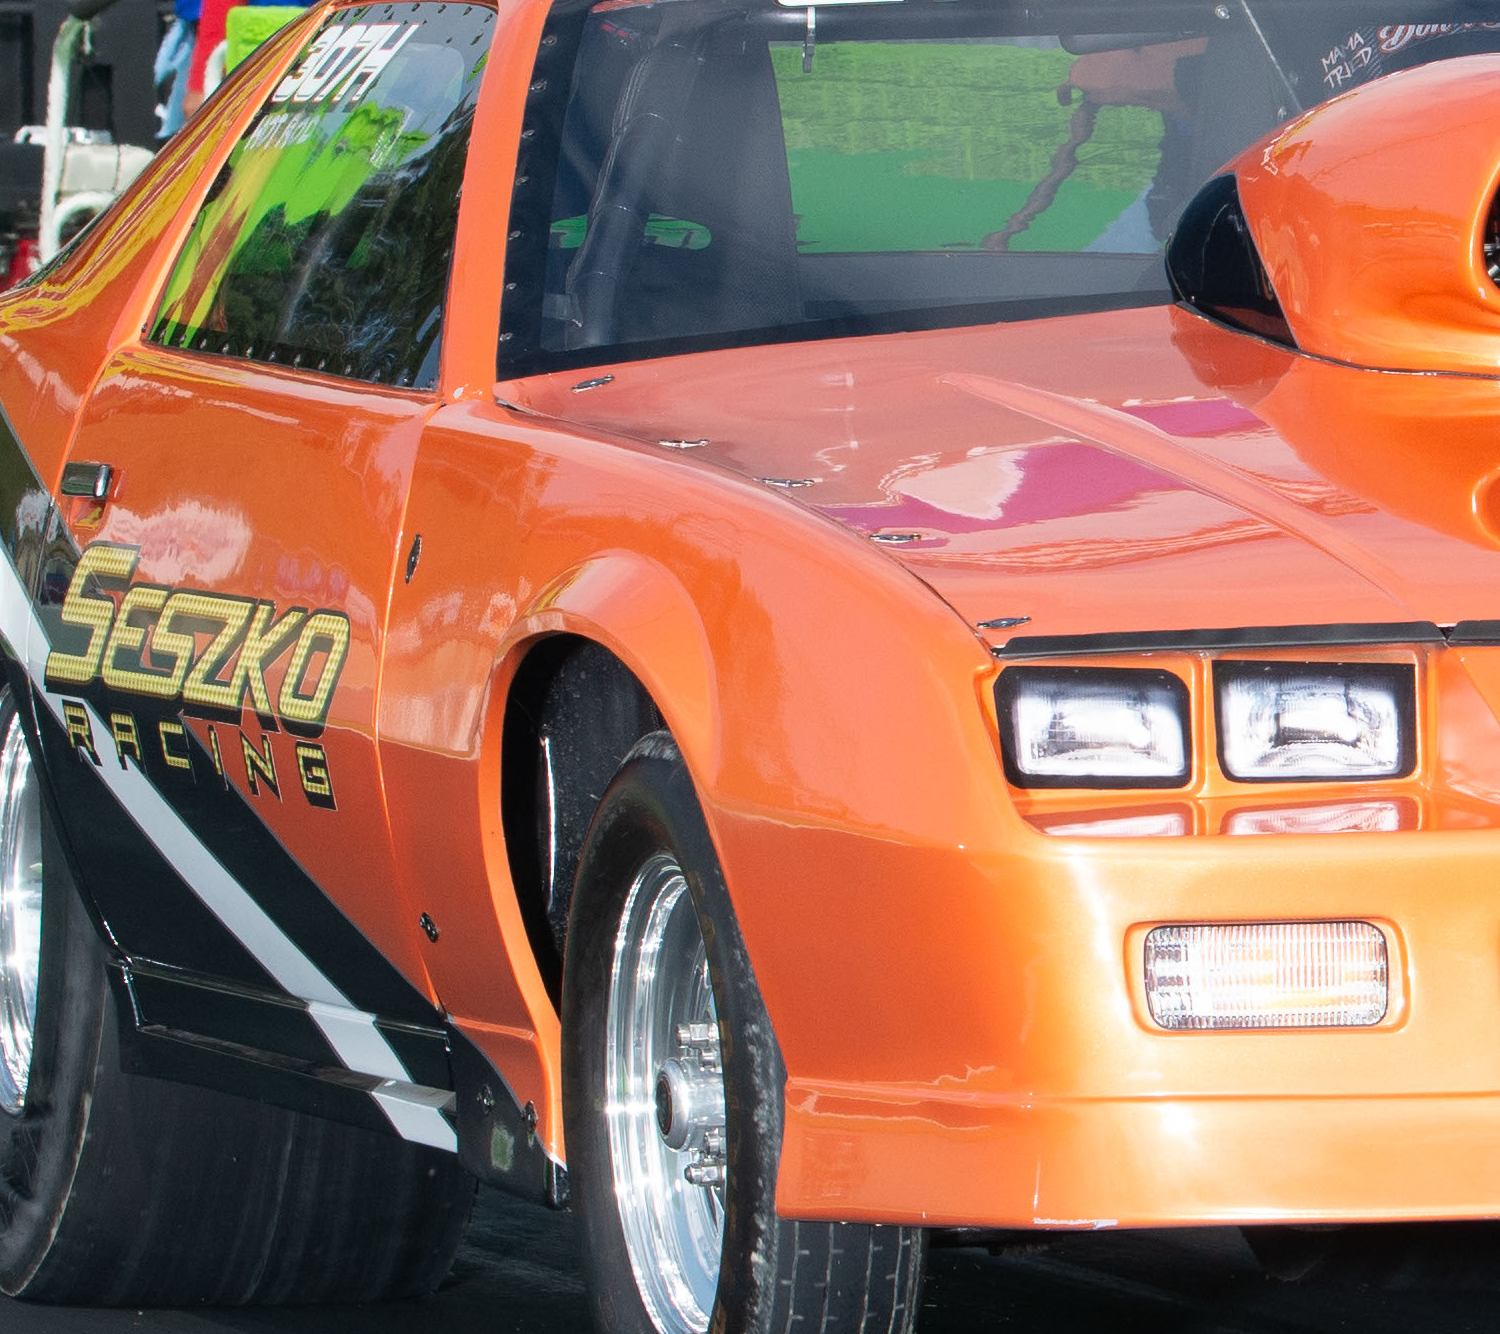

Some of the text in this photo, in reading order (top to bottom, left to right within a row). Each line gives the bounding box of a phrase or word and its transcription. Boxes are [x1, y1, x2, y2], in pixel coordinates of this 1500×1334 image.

[269, 23, 421, 103] 307H
[1321, 32, 1366, 73] MAMA
[1323, 46, 1373, 88] TRIED
[243, 113, 290, 150] HOT
[275, 112, 321, 149] ROD
[63, 702, 336, 807] RACING
